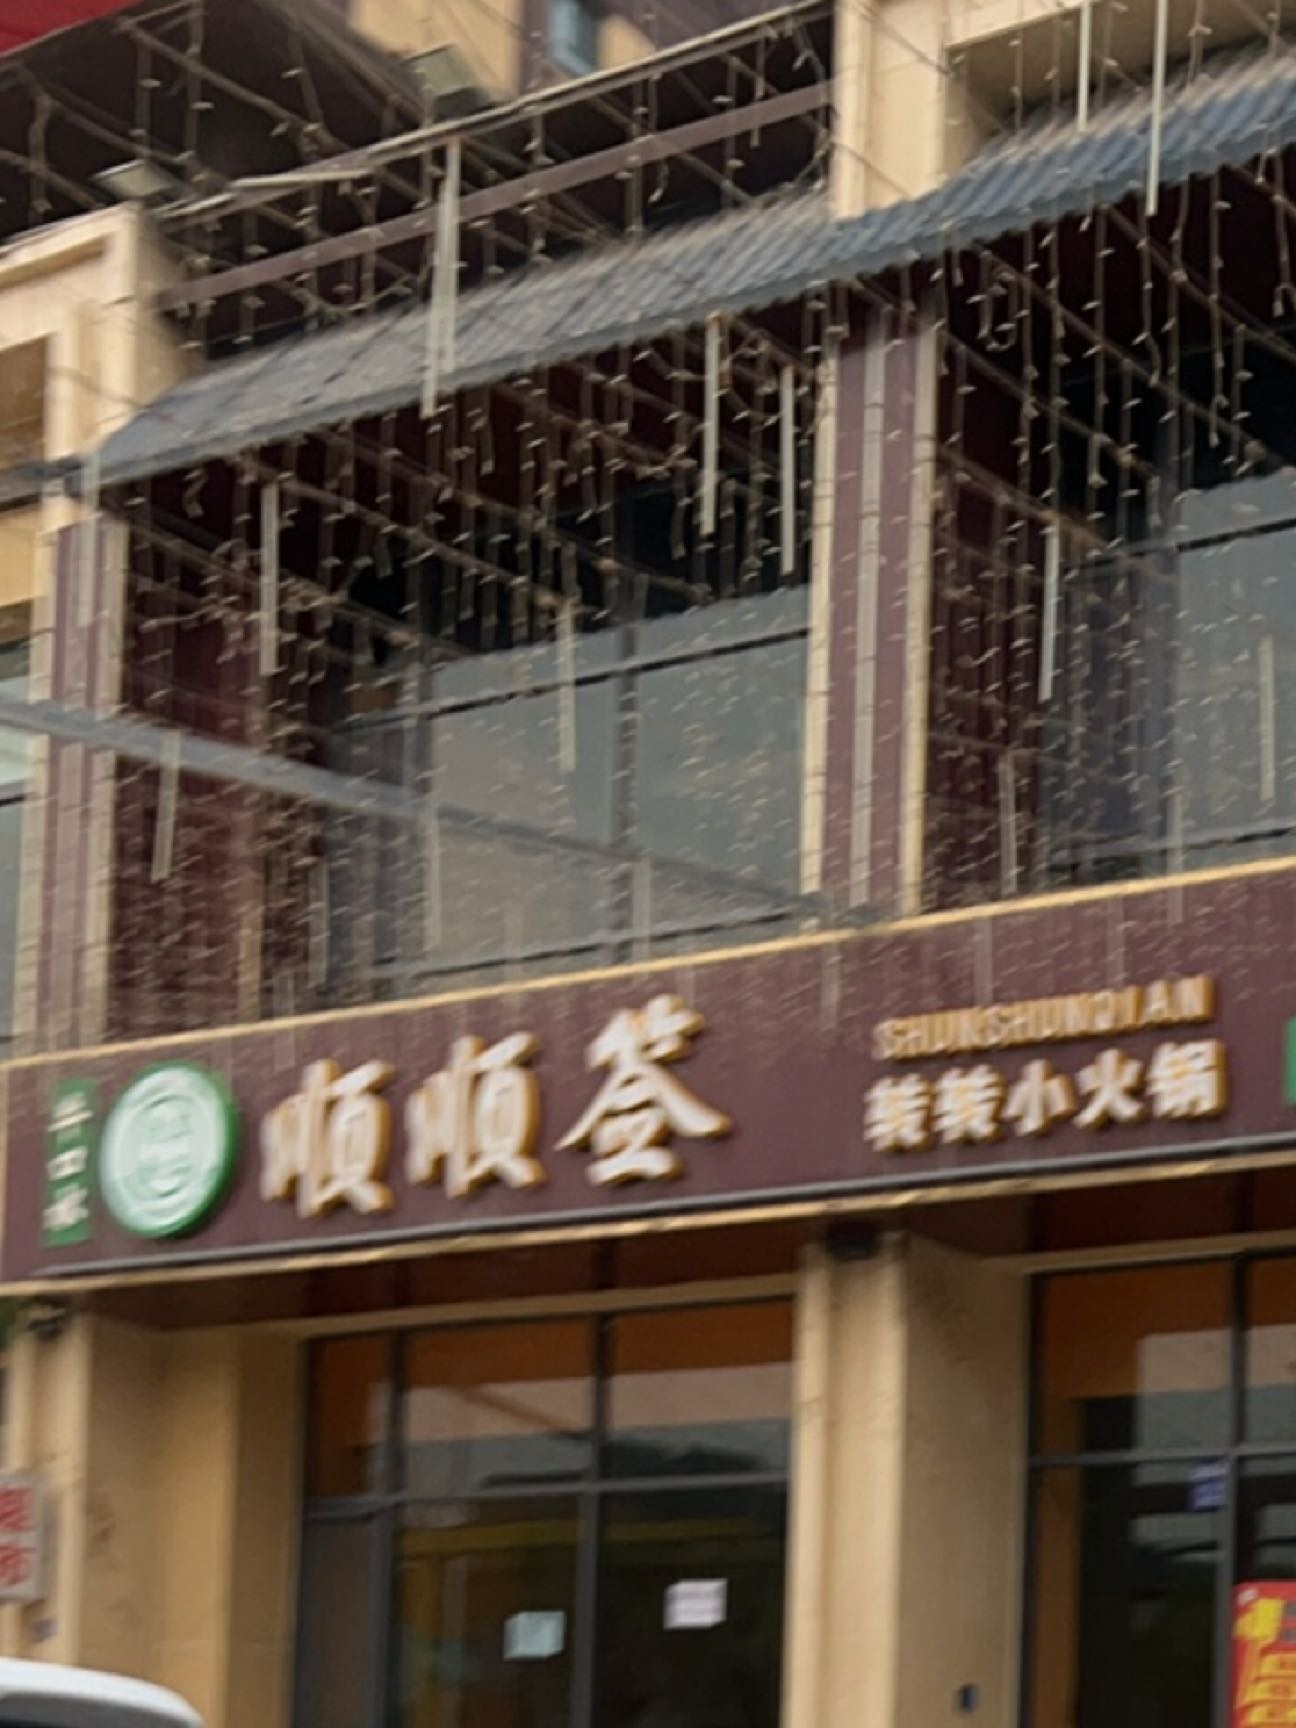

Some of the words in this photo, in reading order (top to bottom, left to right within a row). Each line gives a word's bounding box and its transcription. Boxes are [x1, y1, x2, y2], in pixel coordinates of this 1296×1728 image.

[260, 996, 732, 1217] 顺顺签
[863, 1038, 1226, 1152] 转转小火锅
